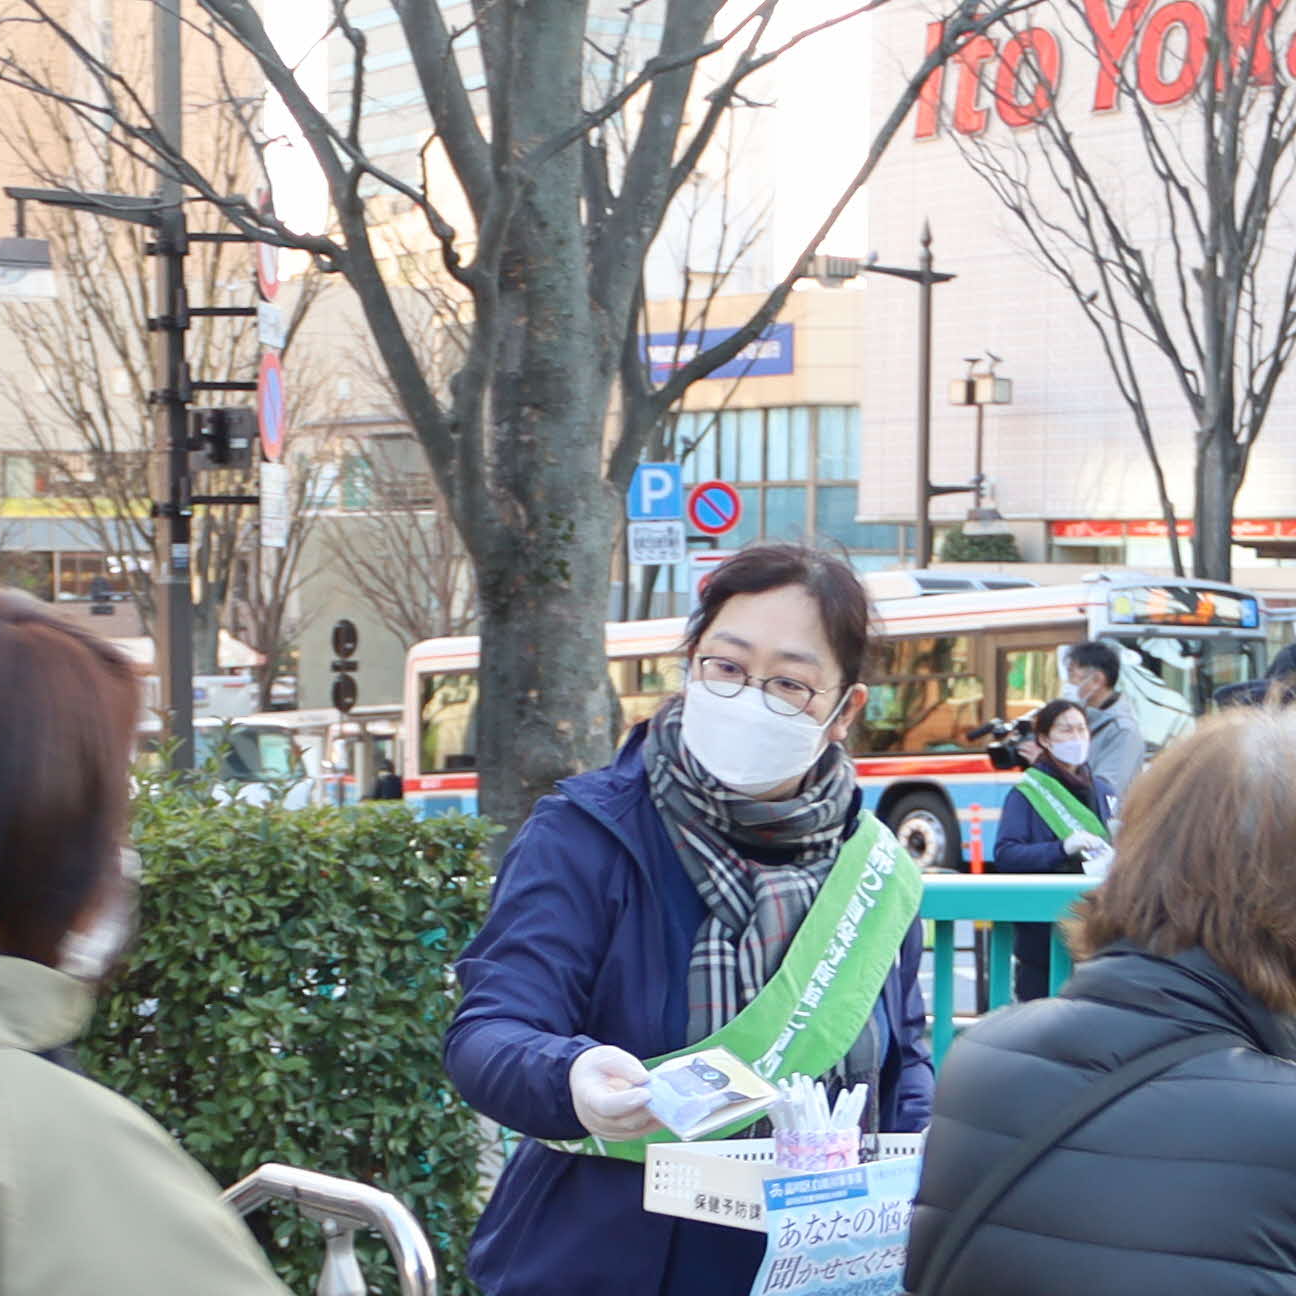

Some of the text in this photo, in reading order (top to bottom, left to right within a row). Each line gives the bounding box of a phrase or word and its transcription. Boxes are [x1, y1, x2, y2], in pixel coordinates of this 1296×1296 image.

[914, 20, 1060, 139] Ito
[641, 469, 674, 514] P
[694, 1193, 762, 1221] 保健予防課
